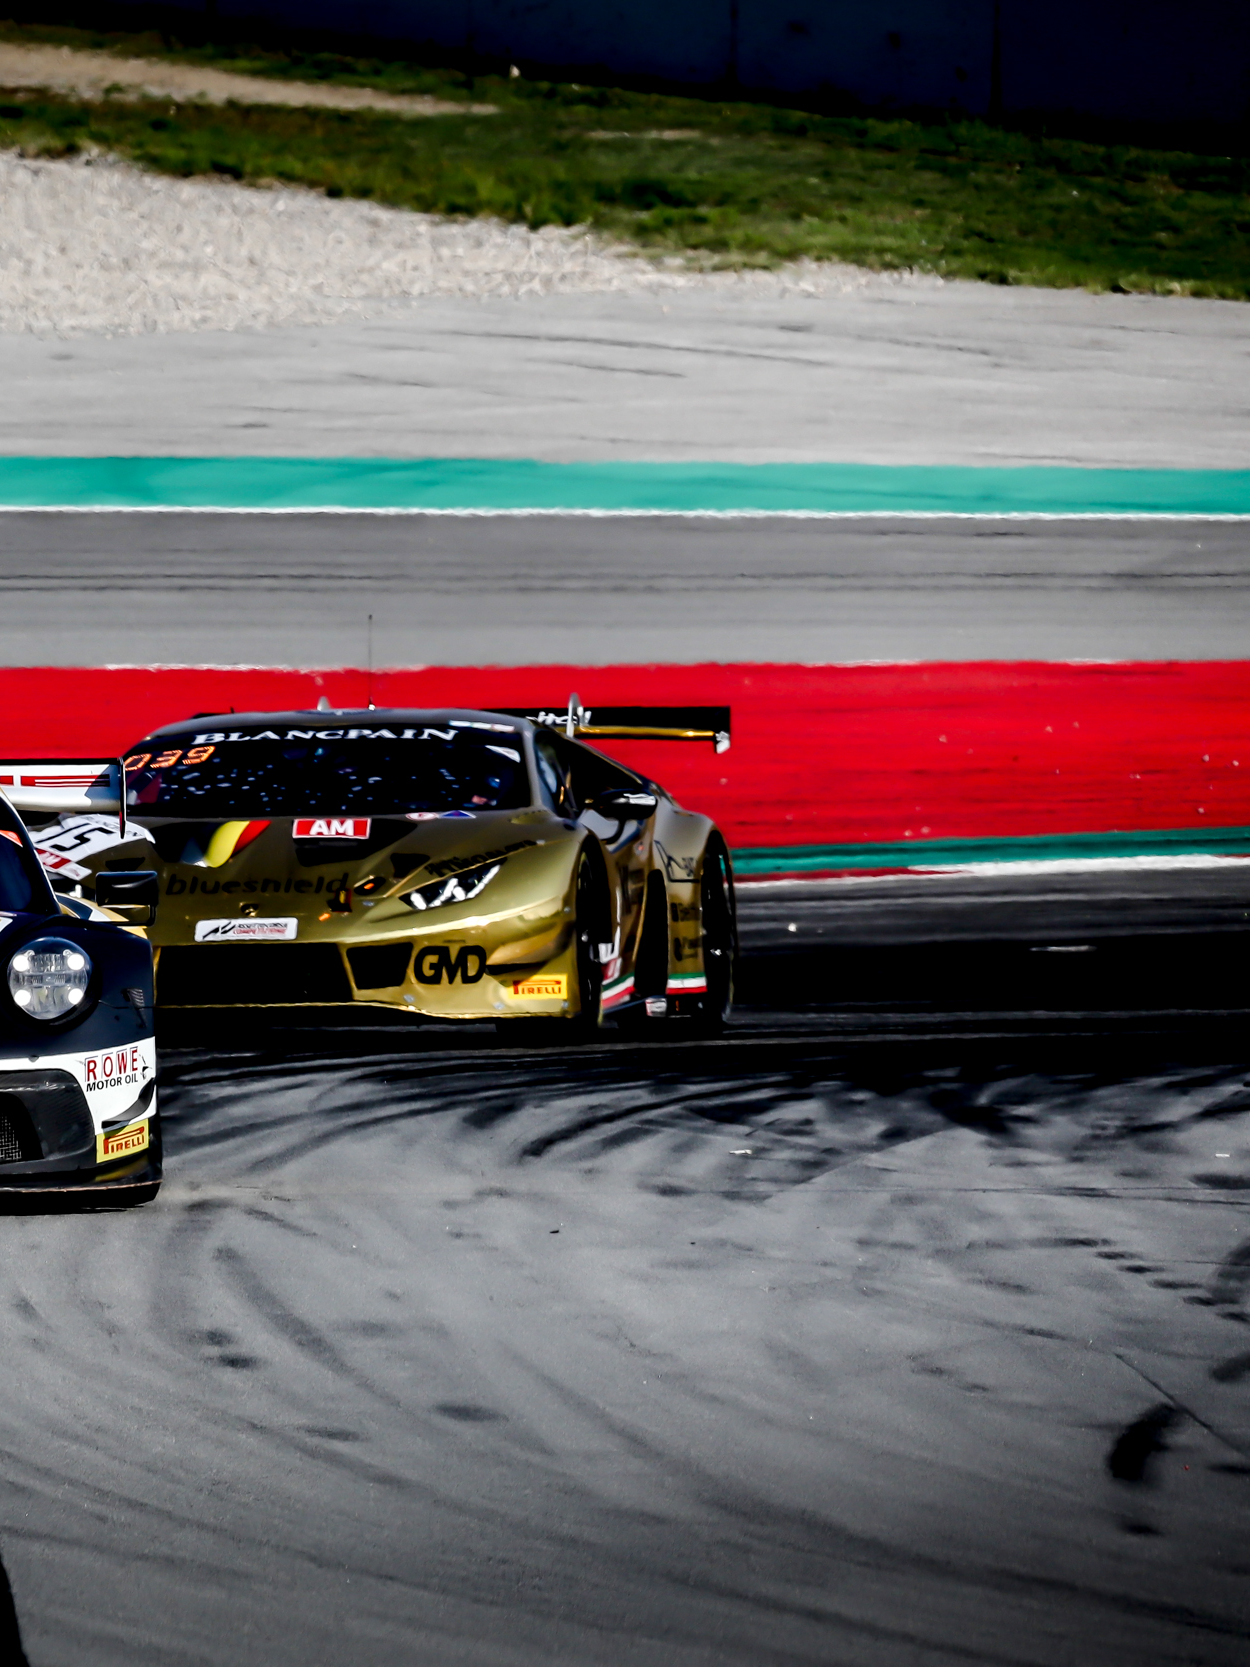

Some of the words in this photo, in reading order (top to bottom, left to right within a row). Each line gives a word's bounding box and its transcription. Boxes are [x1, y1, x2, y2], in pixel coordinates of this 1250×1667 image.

[191, 728, 458, 745] BLANCPAIN
[123, 746, 216, 771] 039
[309, 820, 354, 836] AM
[165, 872, 349, 896] blueshield
[414, 945, 487, 985] GMD
[513, 980, 562, 995] PIRELLI
[87, 1048, 138, 1081] ROWE
[86, 1076, 122, 1092] MOTOR
[125, 1073, 138, 1084] OIL
[103, 1126, 145, 1155] PIRELLI
